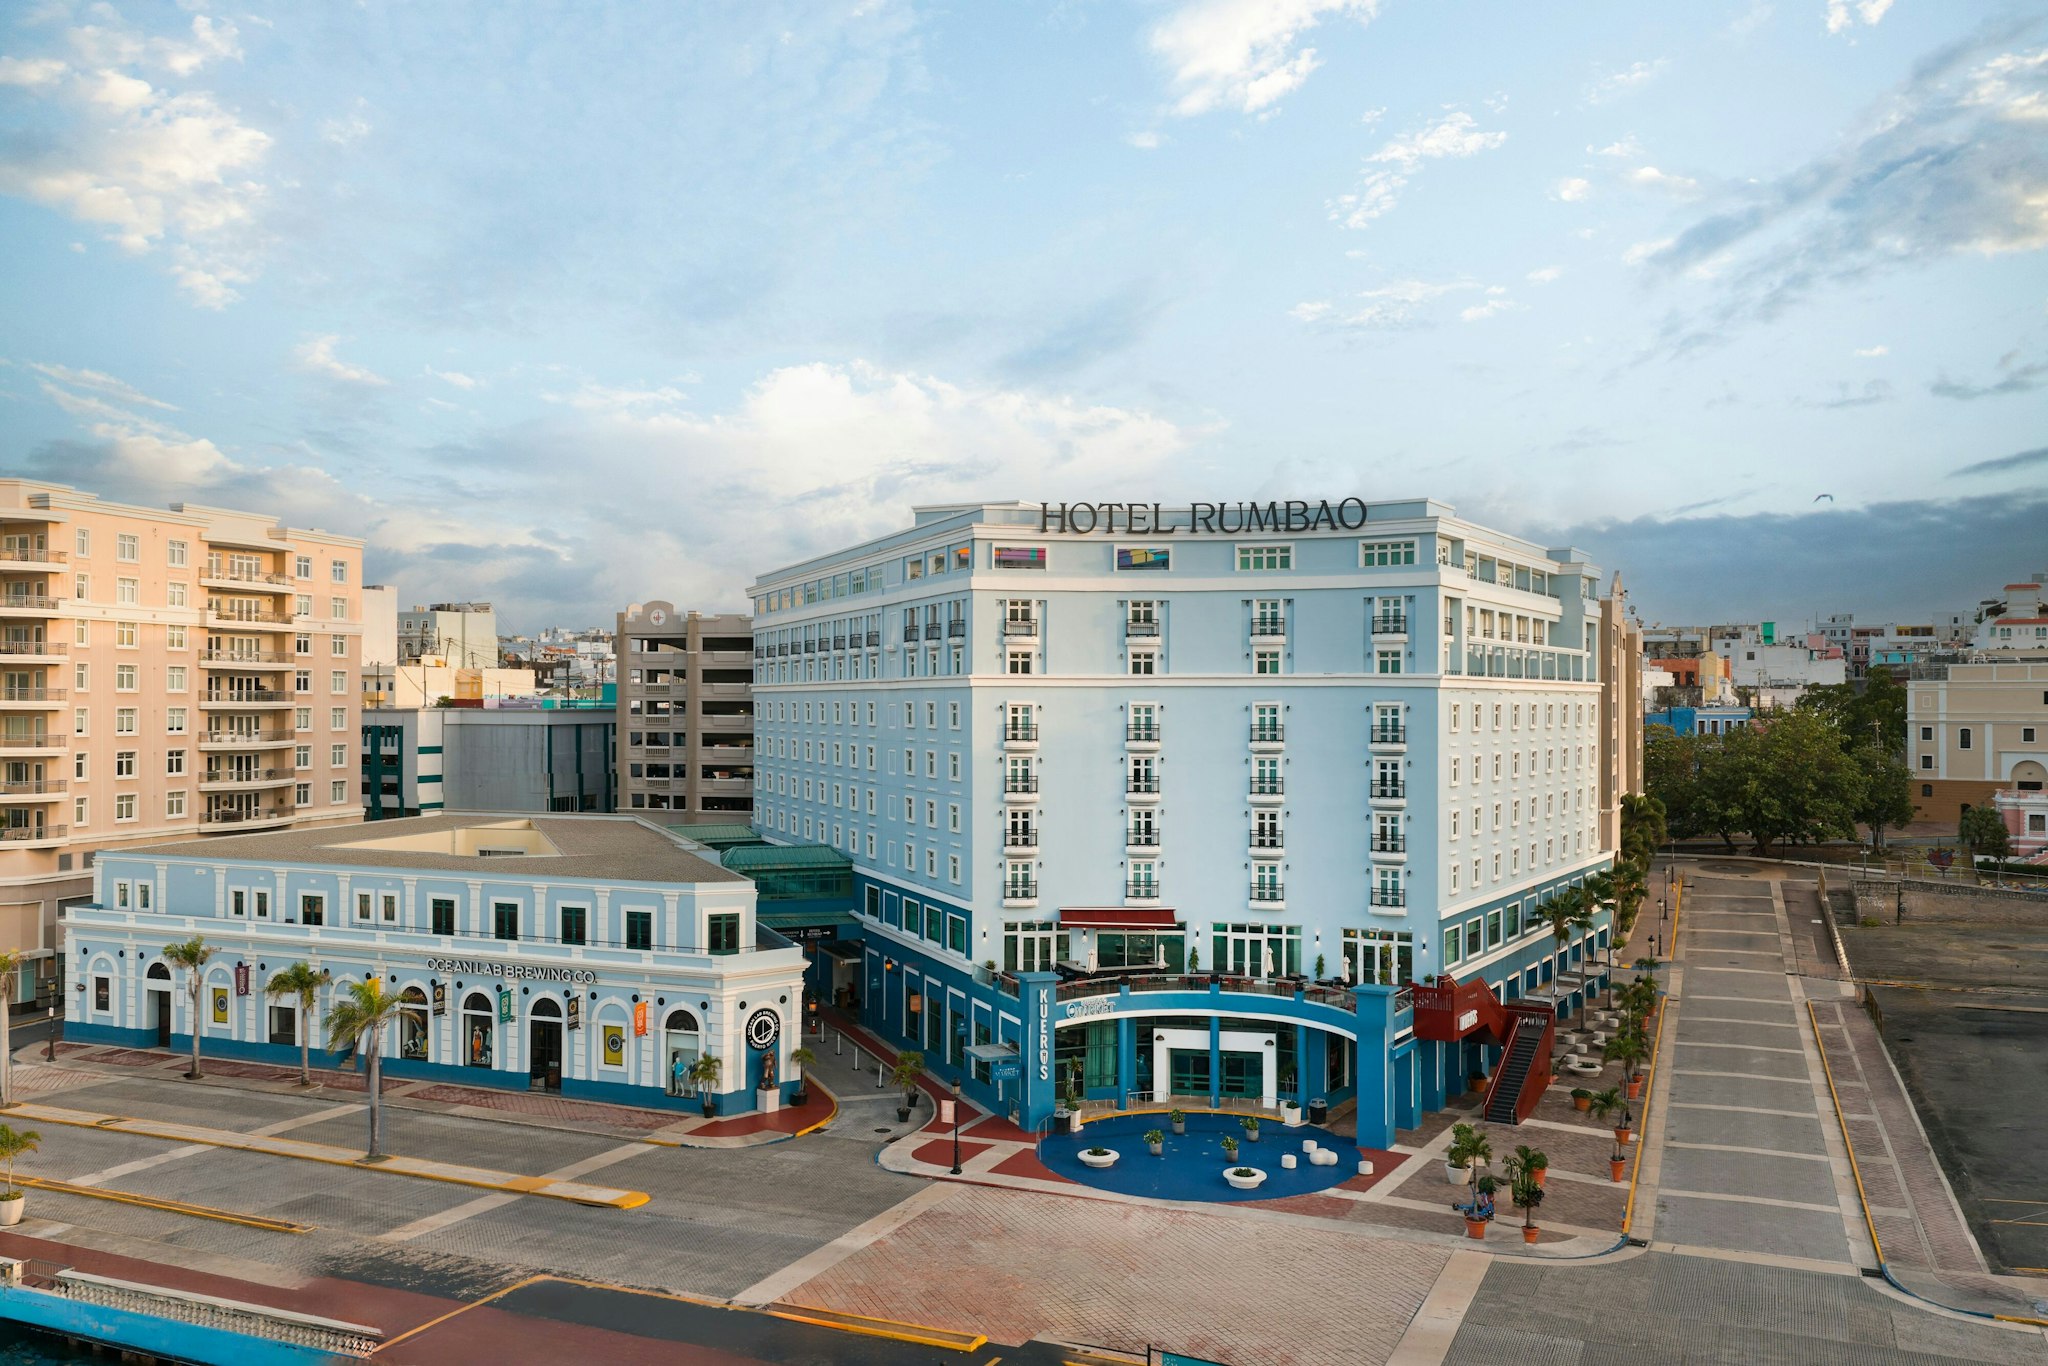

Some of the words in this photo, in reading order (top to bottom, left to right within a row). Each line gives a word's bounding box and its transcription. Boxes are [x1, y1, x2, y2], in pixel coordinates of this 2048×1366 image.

[1040, 502, 1176, 534] HOTEL
[1190, 497, 1367, 534] RUMBAO
[426, 958, 473, 974] OCEAN
[475, 963, 503, 977] LAB
[506, 965, 572, 983] BREWING
[747, 1019, 756, 1036] OCEAN
[754, 1011, 763, 1019] LAB
[1039, 988, 1049, 1081] KUEROS
